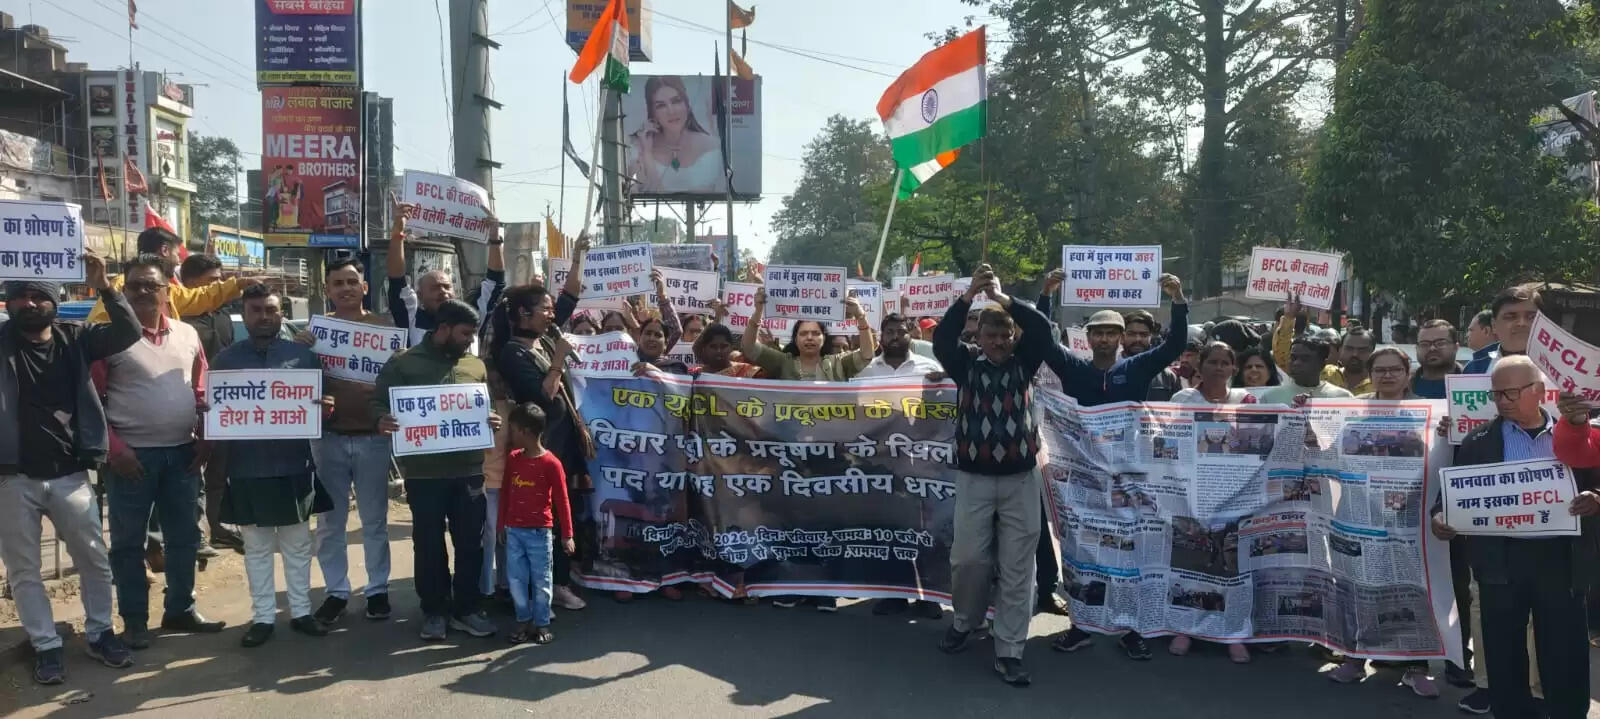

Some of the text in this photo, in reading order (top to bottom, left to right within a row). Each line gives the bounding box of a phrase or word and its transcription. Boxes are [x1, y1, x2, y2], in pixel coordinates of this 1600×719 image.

[265, 134, 357, 159] MEERA
[298, 162, 357, 177] BROTHERS
[416, 181, 444, 200] BFCL
[3, 217, 22, 235] का
[24, 213, 65, 237] शोषण
[0, 250, 20, 268] का
[21, 250, 65, 275] प्रदूषण
[1115, 252, 1132, 262] गया
[598, 266, 620, 277] इसका
[621, 262, 646, 275] BFCL
[1108, 269, 1138, 281] BFCL
[1261, 258, 1288, 273] BFCL
[1302, 261, 1329, 277] दलाली
[666, 278, 681, 289] एक
[909, 284, 935, 296] BFCL
[728, 292, 754, 307] BFC
[801, 288, 828, 300] BFCL
[1107, 288, 1120, 299] का
[353, 331, 387, 351] BFCL
[1537, 328, 1588, 375] BFCL
[348, 354, 359, 371] के
[213, 380, 314, 405] ट्रांसपोर्ट विभाग
[1452, 390, 1488, 412] प्रदूष
[397, 390, 485, 417] एक युद्ध BFCL के
[613, 387, 657, 408] एक
[736, 397, 766, 418] के
[774, 403, 856, 426] प्रदूषण
[864, 400, 893, 419] के
[219, 406, 249, 427] होश
[270, 405, 308, 425] आओ
[405, 425, 438, 447] प्रदूषण
[440, 420, 450, 438] के
[588, 419, 667, 455] बिहार
[707, 430, 737, 457] के
[745, 440, 836, 468] प्रदूषण
[844, 435, 878, 457] के
[601, 467, 647, 490] पद
[722, 475, 772, 497] एक
[780, 471, 893, 497] दिवसीय
[1451, 473, 1496, 489] मानवता
[1498, 472, 1515, 485] का
[1517, 467, 1554, 484] शोषण
[1457, 490, 1564, 510] नाम इसका BFCL
[1472, 516, 1489, 527] का
[1495, 513, 1535, 530] प्रदूषण
[873, 529, 893, 542] 10
[893, 547, 919, 561] तक
